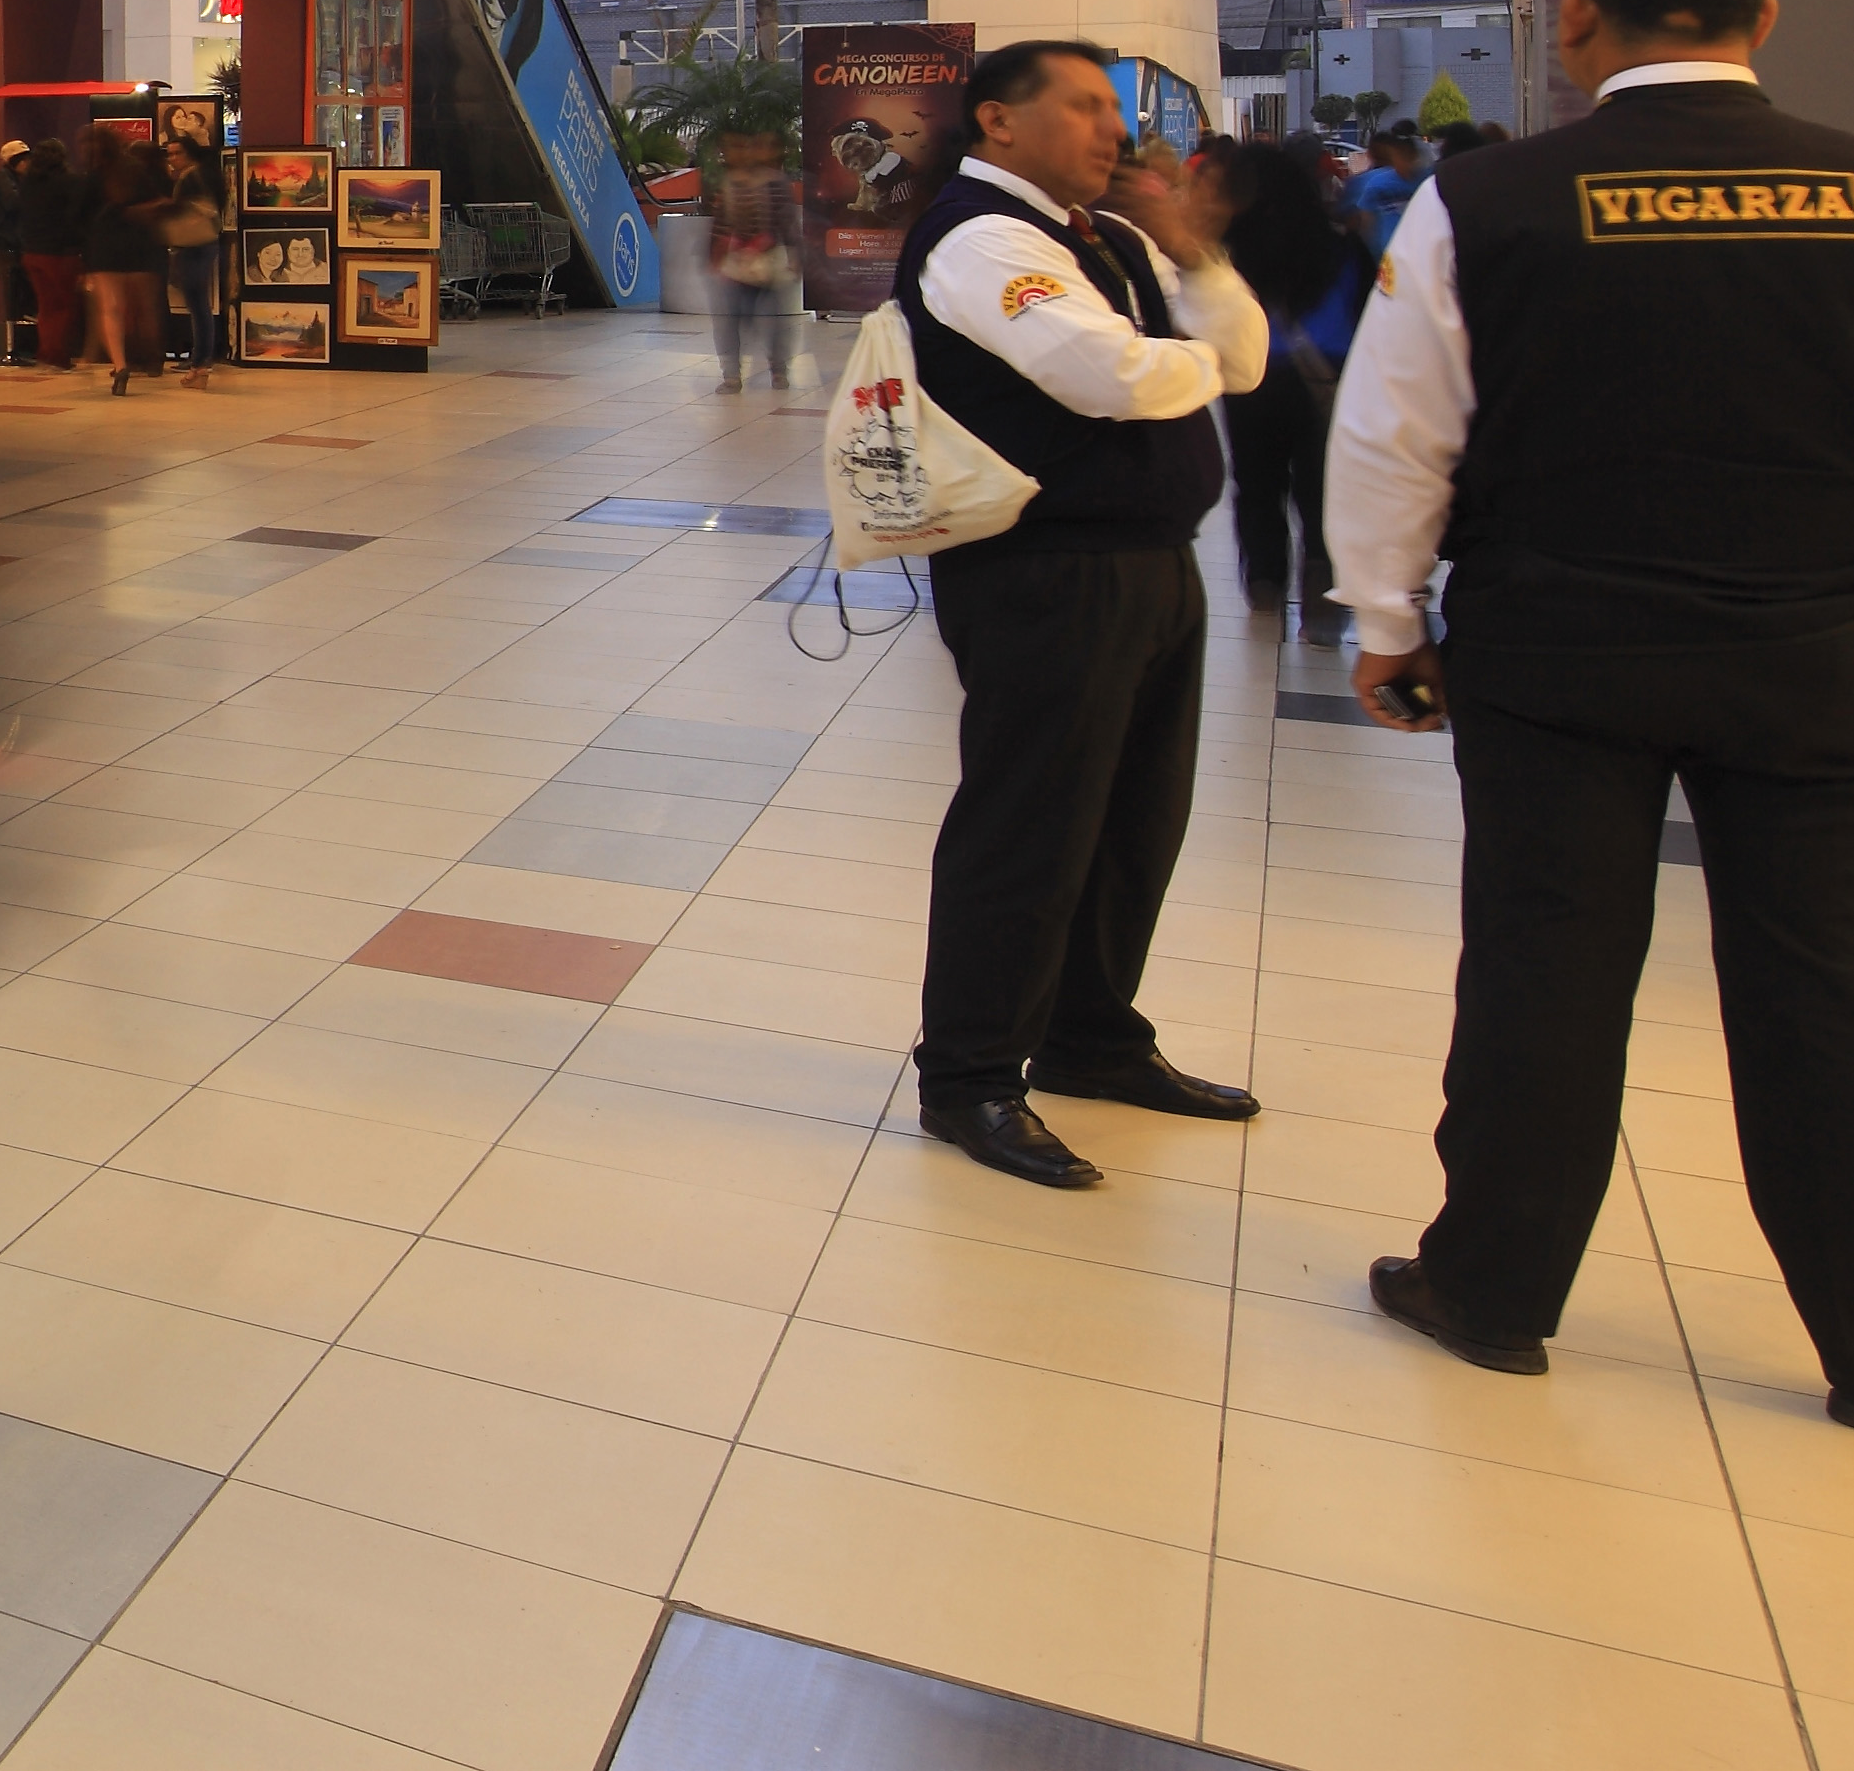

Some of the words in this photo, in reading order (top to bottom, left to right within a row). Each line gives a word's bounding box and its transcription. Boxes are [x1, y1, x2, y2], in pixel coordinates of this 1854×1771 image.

[813, 63, 958, 87] CANOWEEN
[836, 54, 867, 64] MEGA
[869, 53, 929, 64] CONCURSO
[932, 53, 946, 61] DE
[855, 88, 867, 96] En
[869, 87, 924, 98] MegaPlaza
[568, 69, 605, 159] DESCUBRE
[559, 89, 600, 192] PARIS
[550, 140, 591, 229] MEGAPLAZA
[1587, 184, 1854, 225] VIGARZA
[616, 232, 635, 276] paris
